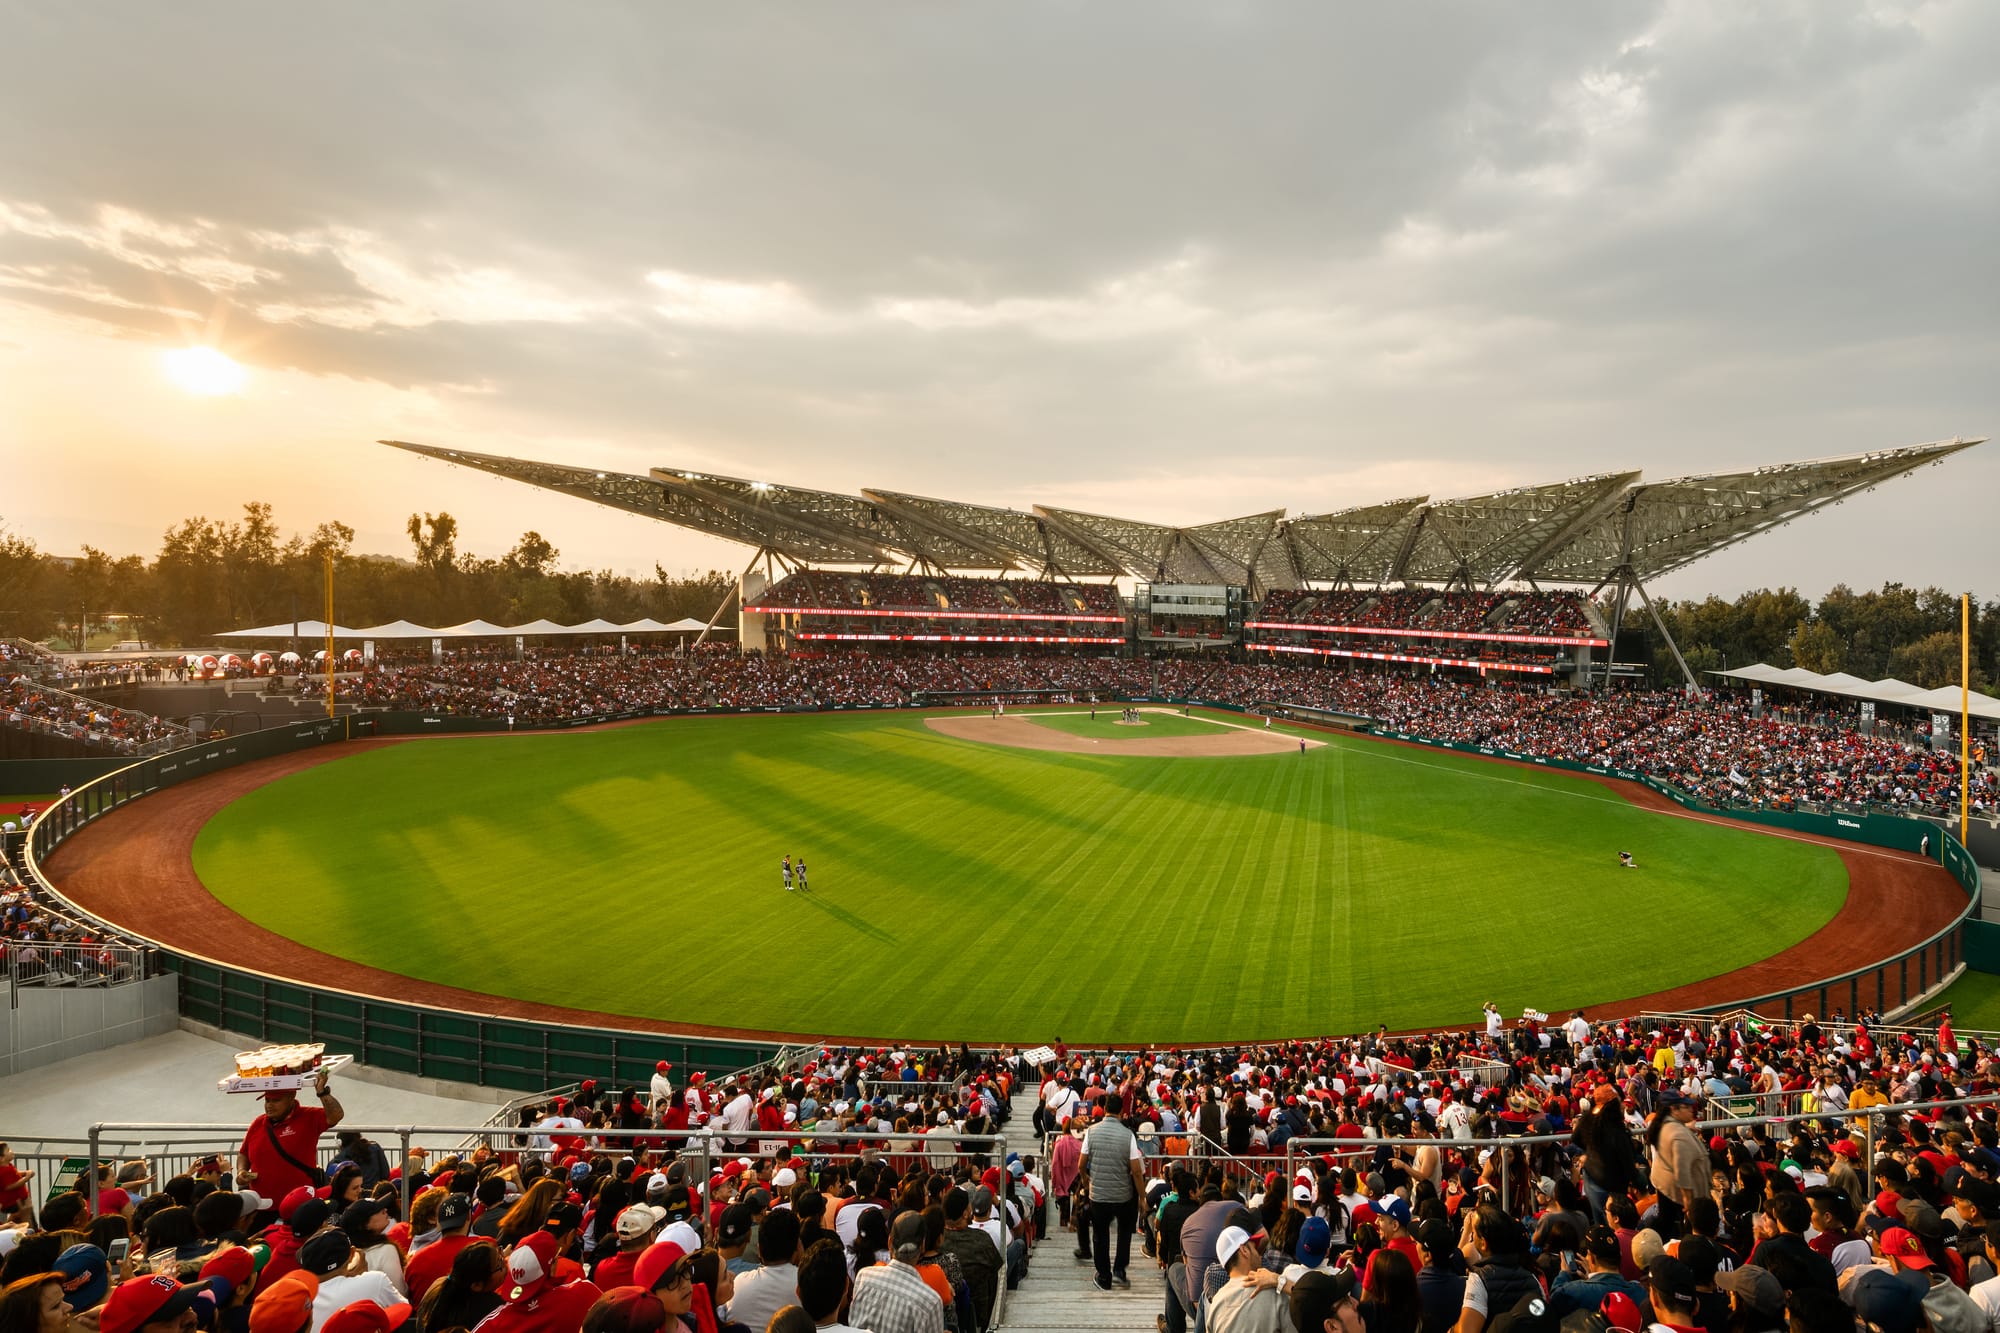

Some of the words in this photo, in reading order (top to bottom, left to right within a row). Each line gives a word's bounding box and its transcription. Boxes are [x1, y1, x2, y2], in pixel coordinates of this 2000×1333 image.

[1862, 703, 1874, 711] B8
[1934, 716, 1949, 724] B9
[1617, 770, 1636, 780] Kivac
[1837, 818, 1861, 829] Wilson
[1455, 1112, 1468, 1127] 13
